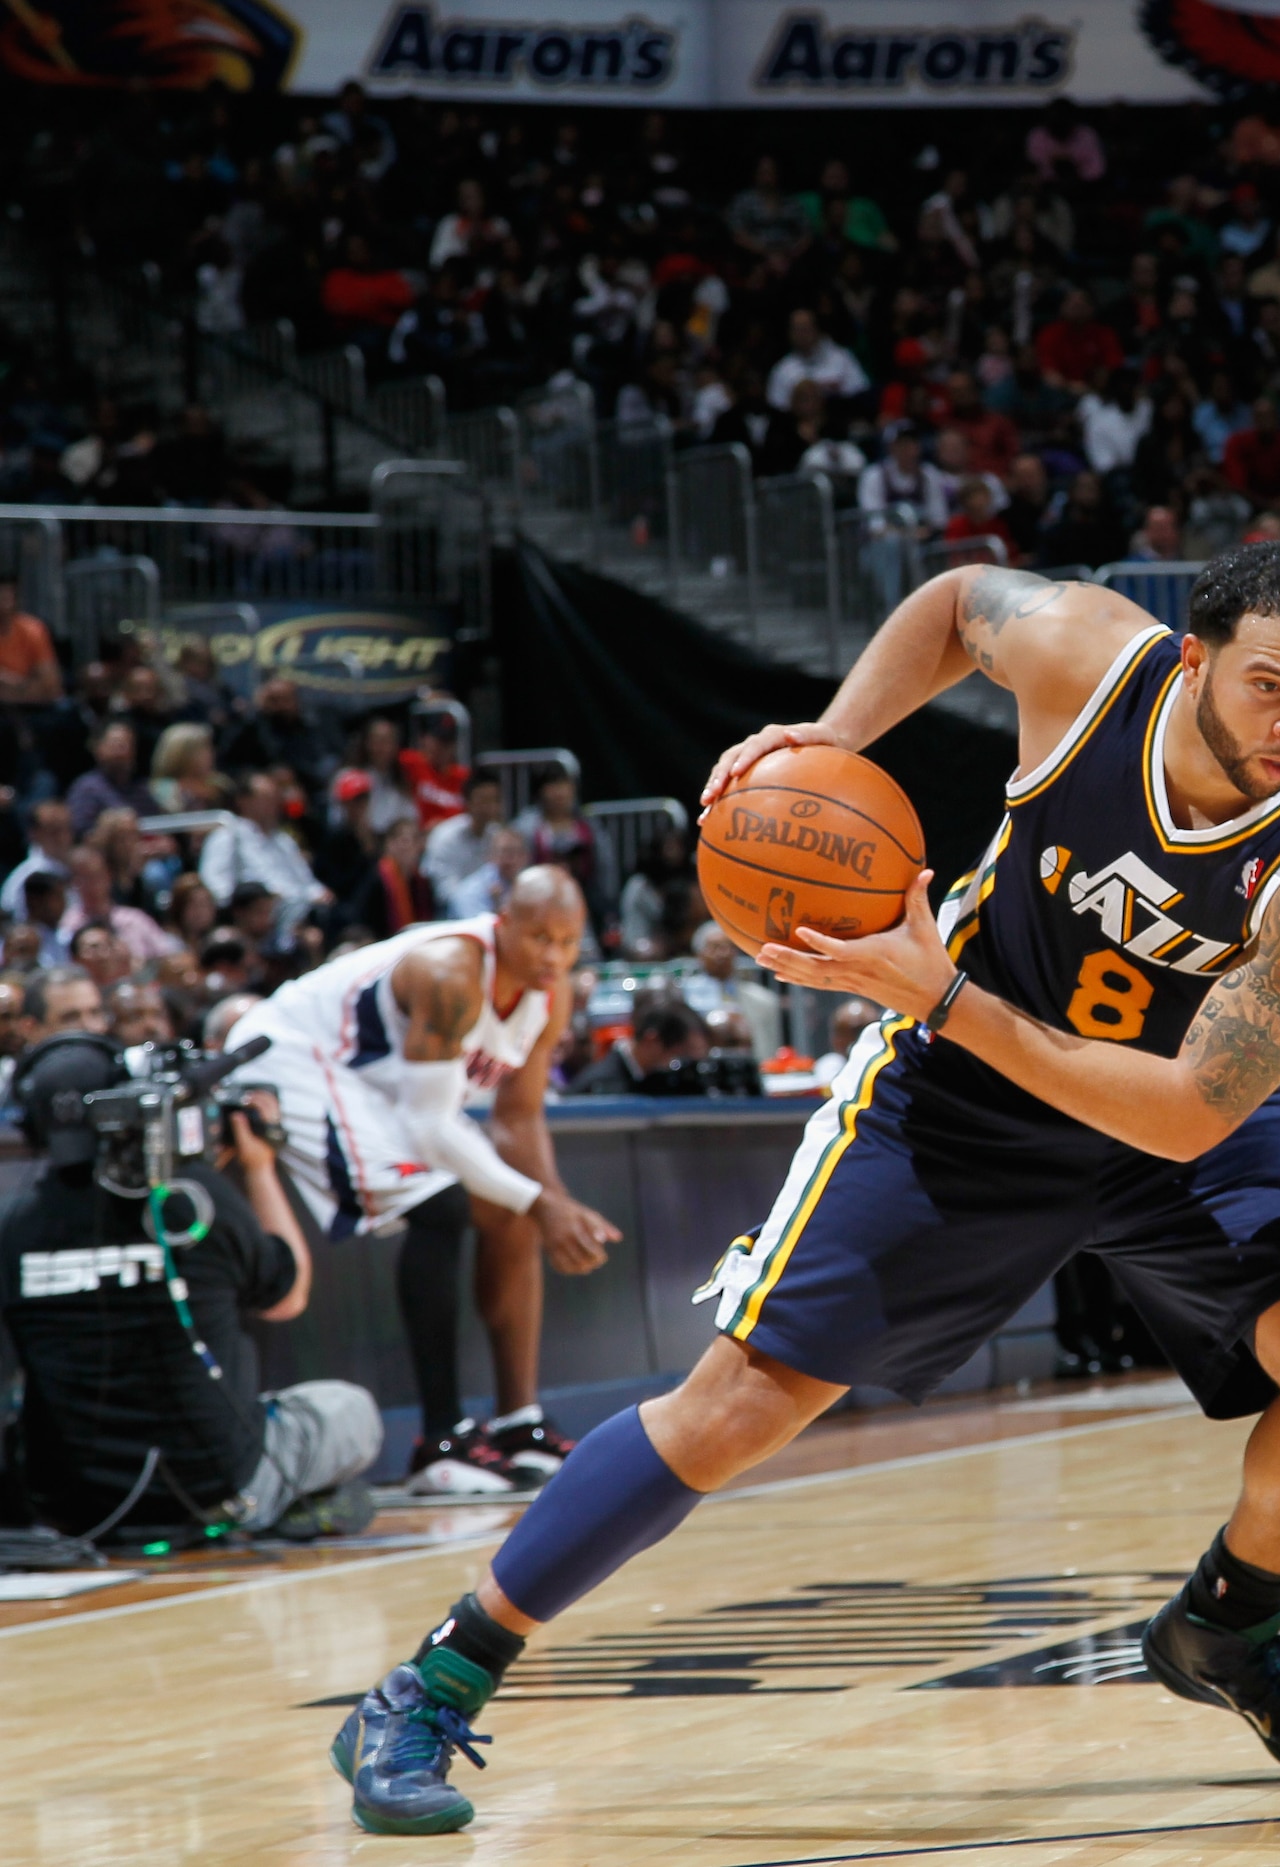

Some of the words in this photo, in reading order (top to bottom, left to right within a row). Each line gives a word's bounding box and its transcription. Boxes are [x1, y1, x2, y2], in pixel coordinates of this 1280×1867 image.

[372, 2, 676, 84] Aaron's
[762, 10, 1073, 86] Aaron's
[724, 806, 877, 882] SPALDING
[1068, 850, 1242, 977] JAZZ
[1066, 948, 1155, 1042] 8
[20, 1244, 166, 1298] ESPN
